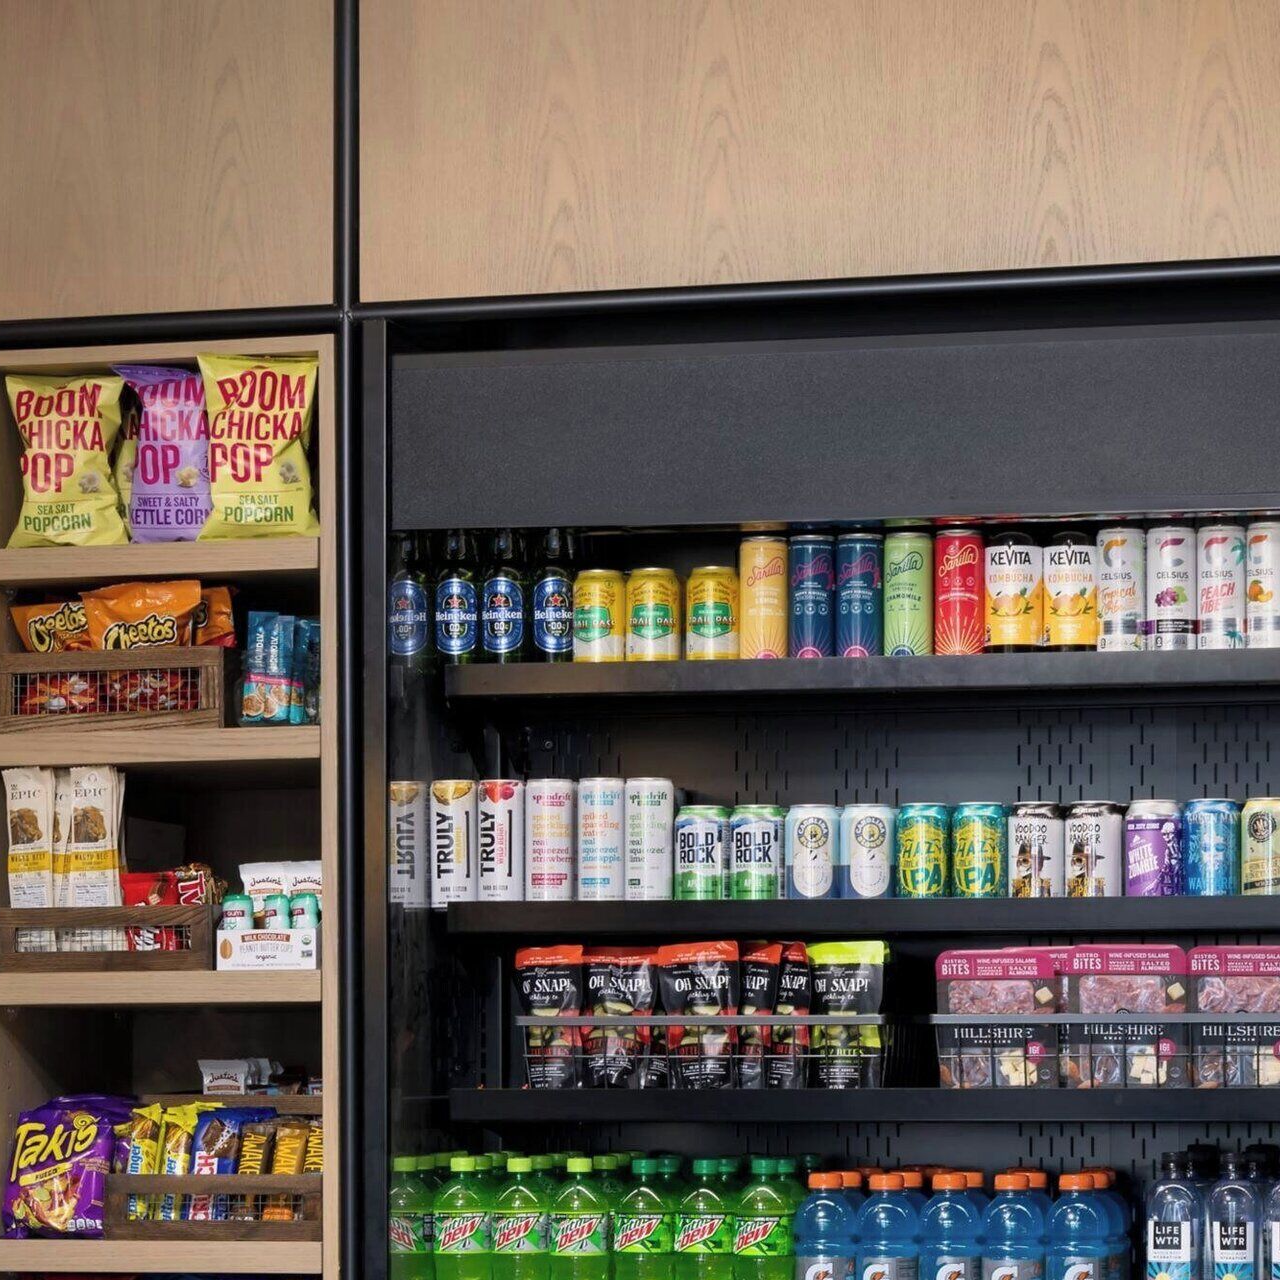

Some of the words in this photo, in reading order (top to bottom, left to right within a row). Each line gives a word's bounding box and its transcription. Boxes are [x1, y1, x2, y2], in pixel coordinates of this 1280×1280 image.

[217, 370, 306, 411] BOOM
[16, 383, 103, 420] BOOM
[212, 411, 302, 441] CHICKA
[210, 442, 273, 483] POP
[137, 496, 160, 508] SWEET
[163, 497, 172, 507] &
[174, 496, 199, 508] SALTY
[239, 494, 257, 505] SEA
[259, 494, 278, 505] SALT
[37, 504, 52, 515] SEA
[54, 503, 75, 514] SALT
[224, 506, 294, 523] POPCORN
[24, 513, 92, 532] POPCORN
[989, 572, 1034, 584] KOMBUCHA
[1048, 572, 1093, 584] KOMBUCHA
[1101, 572, 1132, 580] CELSIUS
[1156, 571, 1189, 580] CELSIUS
[1201, 570, 1233, 579] CELSIUS
[1201, 582, 1236, 599] PEACH
[887, 593, 923, 603] CHAMOMILE
[436, 611, 477, 621] Heineken
[482, 610, 522, 620] Heineken
[104, 617, 175, 650] Cheetos
[11, 789, 39, 800] EPIC
[74, 788, 103, 798] EPIC
[532, 791, 572, 804] spindrift
[797, 816, 830, 835] CAROLINA
[854, 816, 886, 835] CAROLINA
[1015, 824, 1048, 834] VOODOO
[1070, 824, 1101, 833] VOODOO
[436, 811, 454, 879] TRULY
[480, 810, 495, 877] TRULY
[680, 831, 715, 849] BOLD
[735, 831, 772, 849] BOLD
[1015, 834, 1048, 845] RANGER
[1070, 834, 1101, 844] RANGER
[680, 847, 716, 864] ROCK
[735, 846, 773, 864] ROCK
[1128, 842, 1153, 861] WHITE
[1129, 856, 1159, 879] ZOMBIE
[534, 976, 571, 993] SNAP!
[589, 975, 605, 990] OH
[609, 976, 647, 994] SNAP!
[675, 977, 692, 993] OH
[695, 974, 731, 991] SNAP!
[815, 979, 827, 993] OH
[830, 977, 870, 993] SNAP!
[954, 1027, 1034, 1040] HILLSHIRE
[1084, 1024, 1164, 1036] HILLSHIRE
[11, 1114, 100, 1182] Takis
[1155, 1225, 1180, 1235] LIFE
[1221, 1225, 1245, 1235] LIFE
[1155, 1235, 1181, 1246] WTR
[1221, 1236, 1246, 1246] WTR
